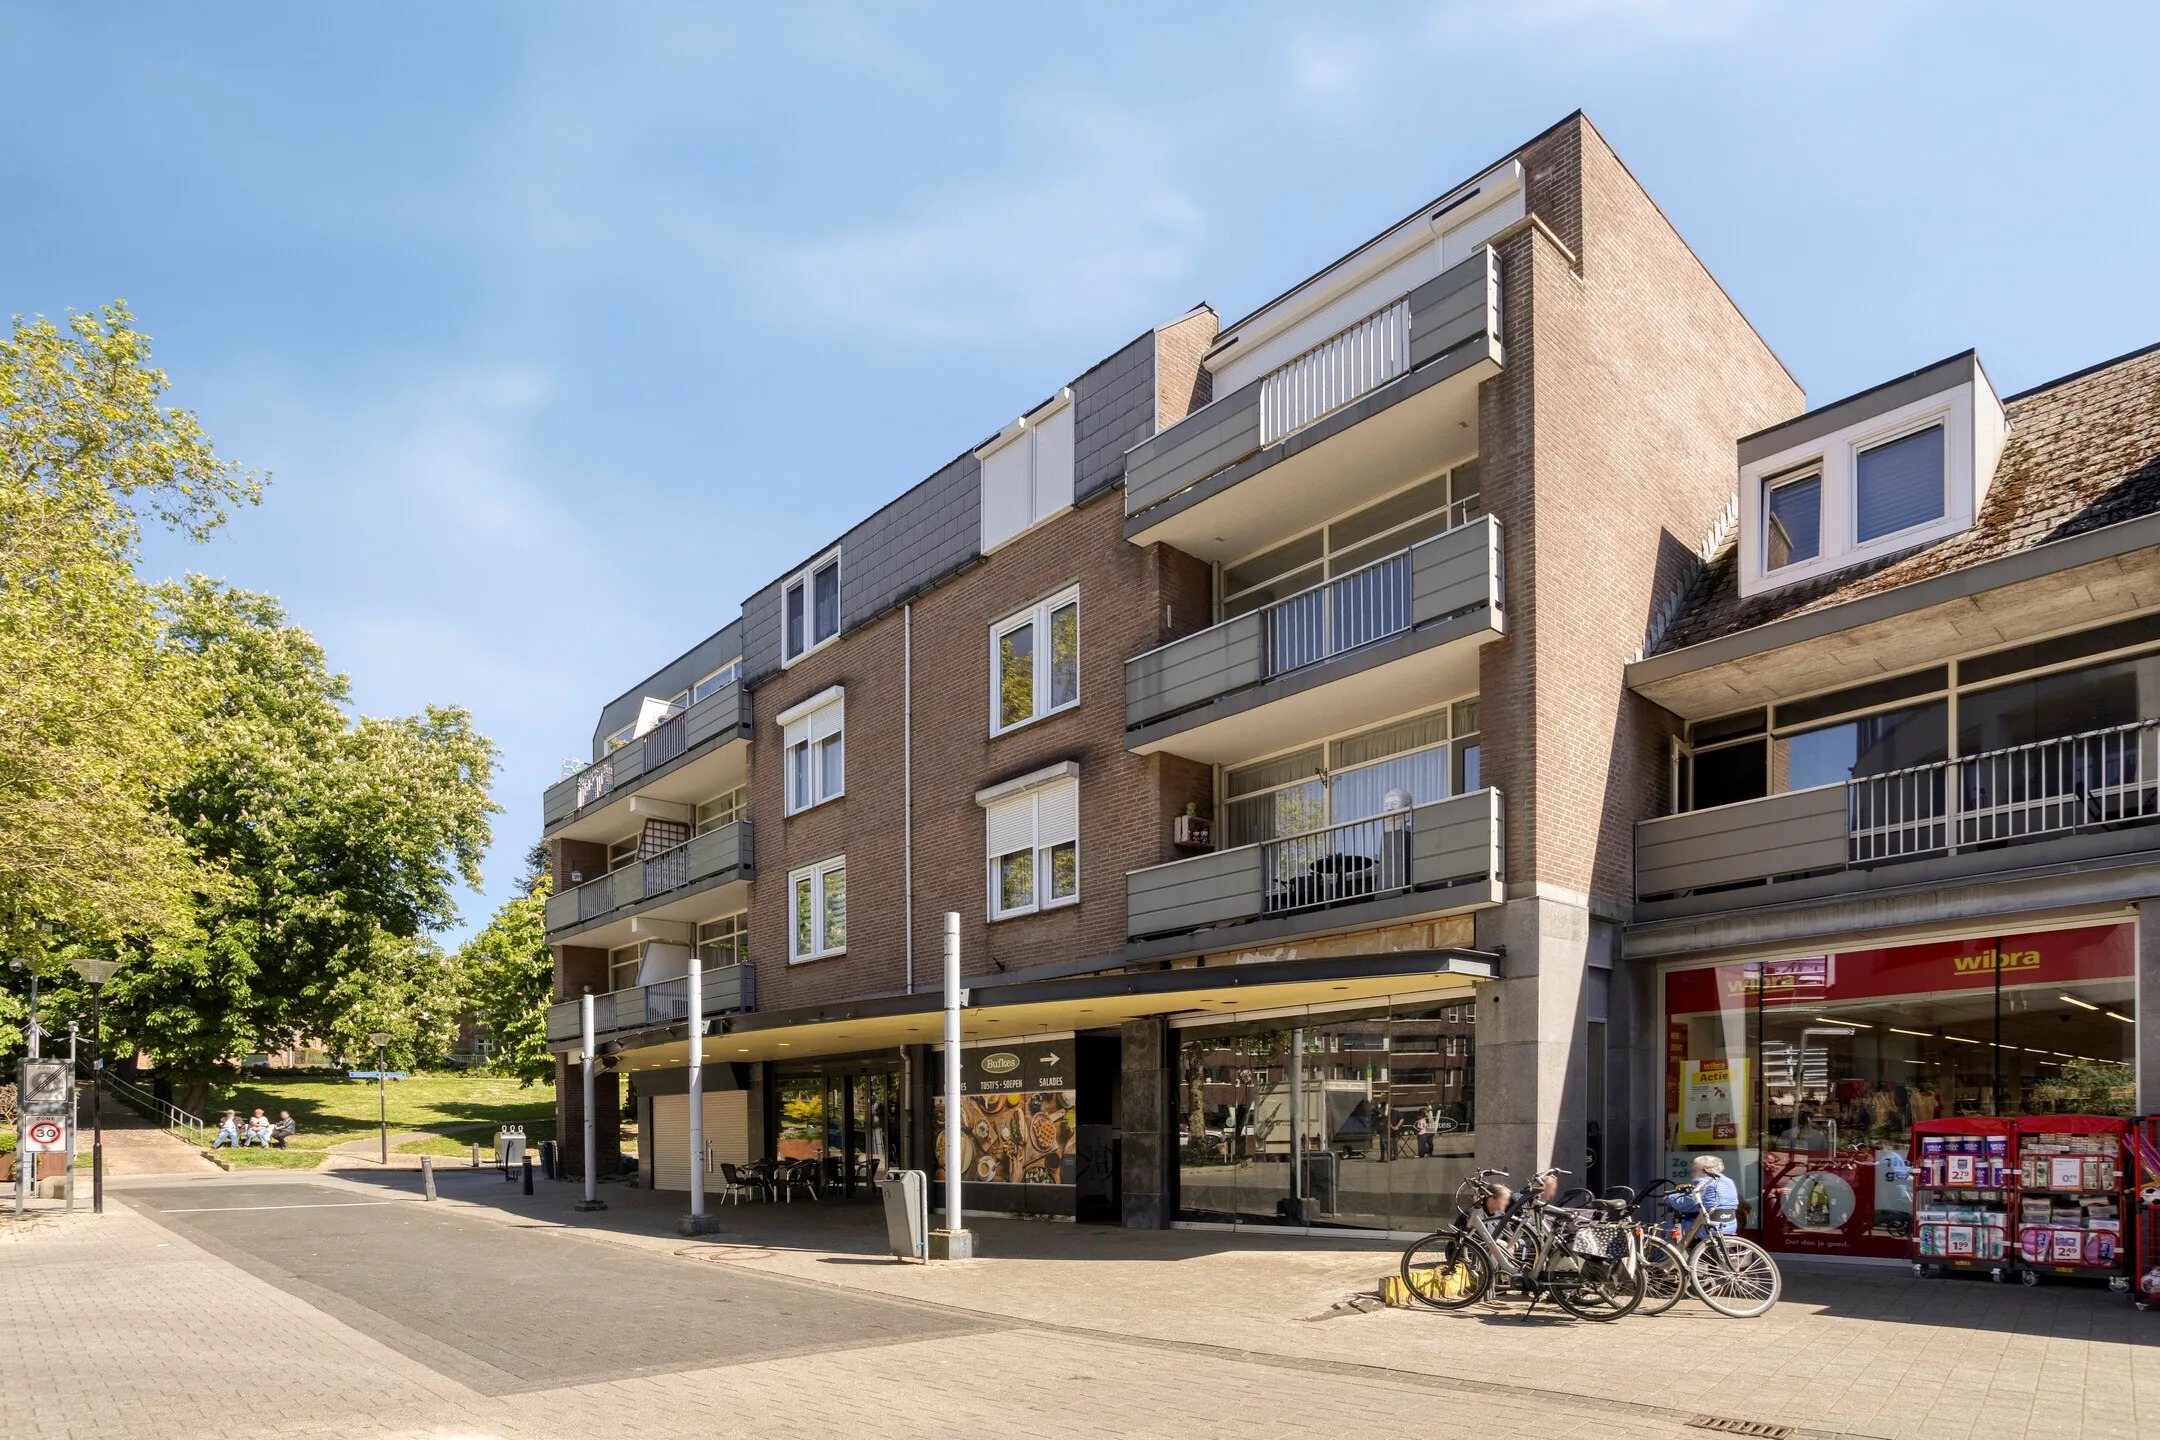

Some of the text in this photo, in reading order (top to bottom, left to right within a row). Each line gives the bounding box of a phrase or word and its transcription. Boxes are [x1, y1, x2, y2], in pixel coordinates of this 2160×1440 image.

[1954, 949, 2040, 972] wibra
[986, 1058, 1016, 1069] Bufkes
[1039, 1077, 1063, 1087] SALADES
[1700, 1072, 1729, 1082] Actie
[980, 1079, 1023, 1090] TOSTI'S SOEPEN
[35, 1129, 56, 1137] 30
[1672, 1158, 1688, 1167] Zo
[1817, 1240, 1825, 1248] je
